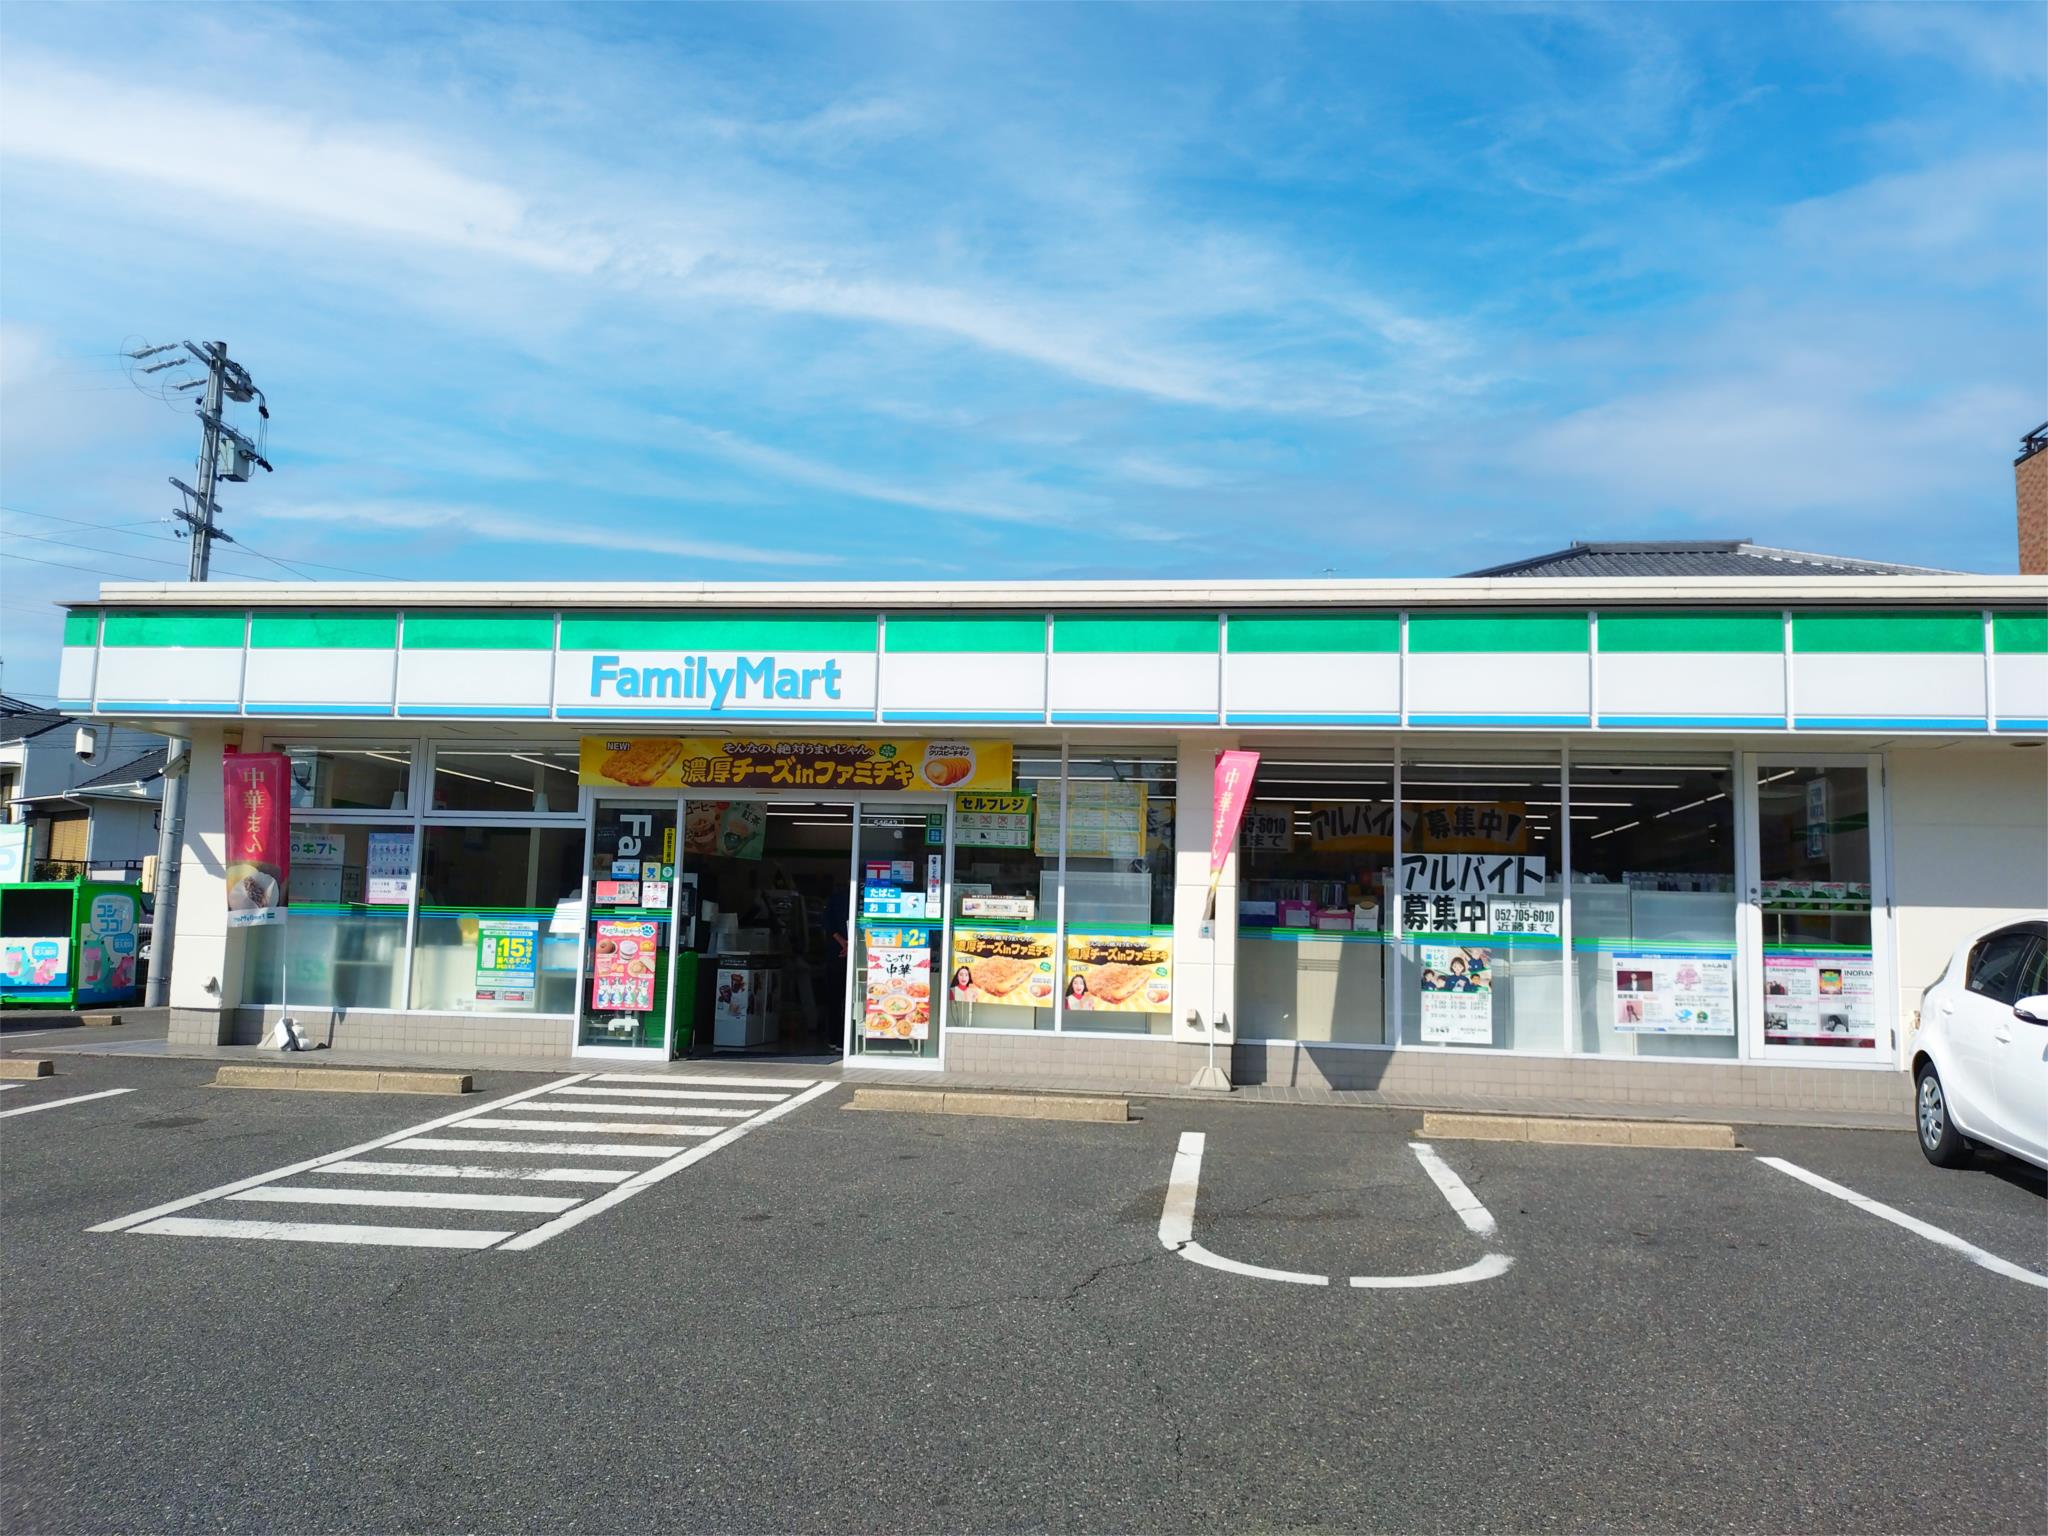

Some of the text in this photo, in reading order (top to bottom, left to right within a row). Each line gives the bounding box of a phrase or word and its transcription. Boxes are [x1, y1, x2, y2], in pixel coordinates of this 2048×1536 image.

[590, 655, 842, 711] FamilyMart
[606, 741, 630, 751] NEW!
[722, 743, 875, 756] そんなの、絶対うまいじゃん。
[682, 756, 915, 787] 濃厚チーズinファミチキ
[961, 797, 1025, 812] セルフレジ
[1213, 767, 1240, 860] 中華まん
[1401, 855, 1544, 894] アルバイト
[870, 888, 896, 898] たばこ
[1403, 894, 1487, 932] 募集中
[1495, 909, 1555, 923] 052-705-6010
[885, 953, 912, 963] こってり
[887, 963, 912, 978] 中華
